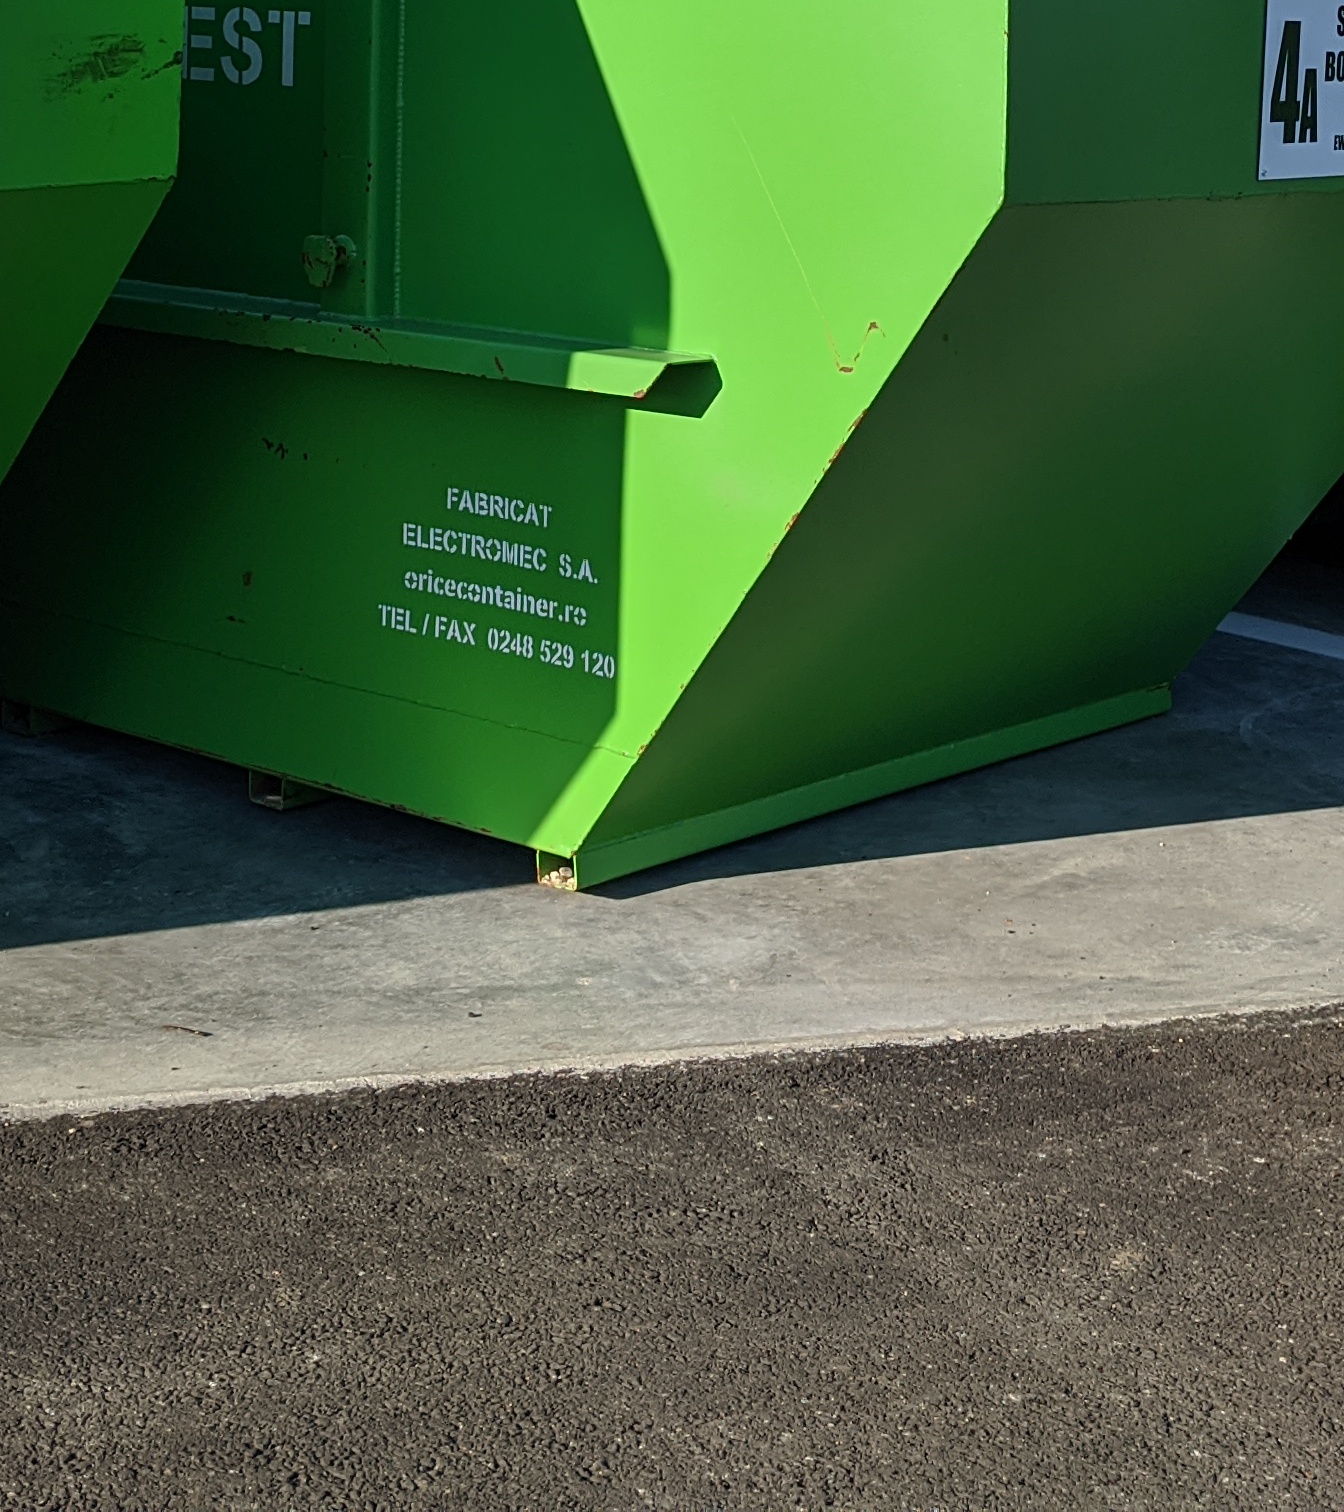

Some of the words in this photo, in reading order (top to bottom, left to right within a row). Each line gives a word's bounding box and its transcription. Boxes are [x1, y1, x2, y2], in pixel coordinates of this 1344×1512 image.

[1269, 20, 1318, 144] 4A
[446, 486, 553, 528] FABRICAT
[402, 522, 548, 572] ELECTROMEC
[558, 552, 599, 584] S.A.
[403, 568, 587, 627] oricecontainer.ro
[378, 603, 417, 634] TEL
[434, 615, 476, 646] FAX
[487, 627, 534, 659] 0248
[539, 639, 574, 669] 529
[580, 649, 615, 679] 120
